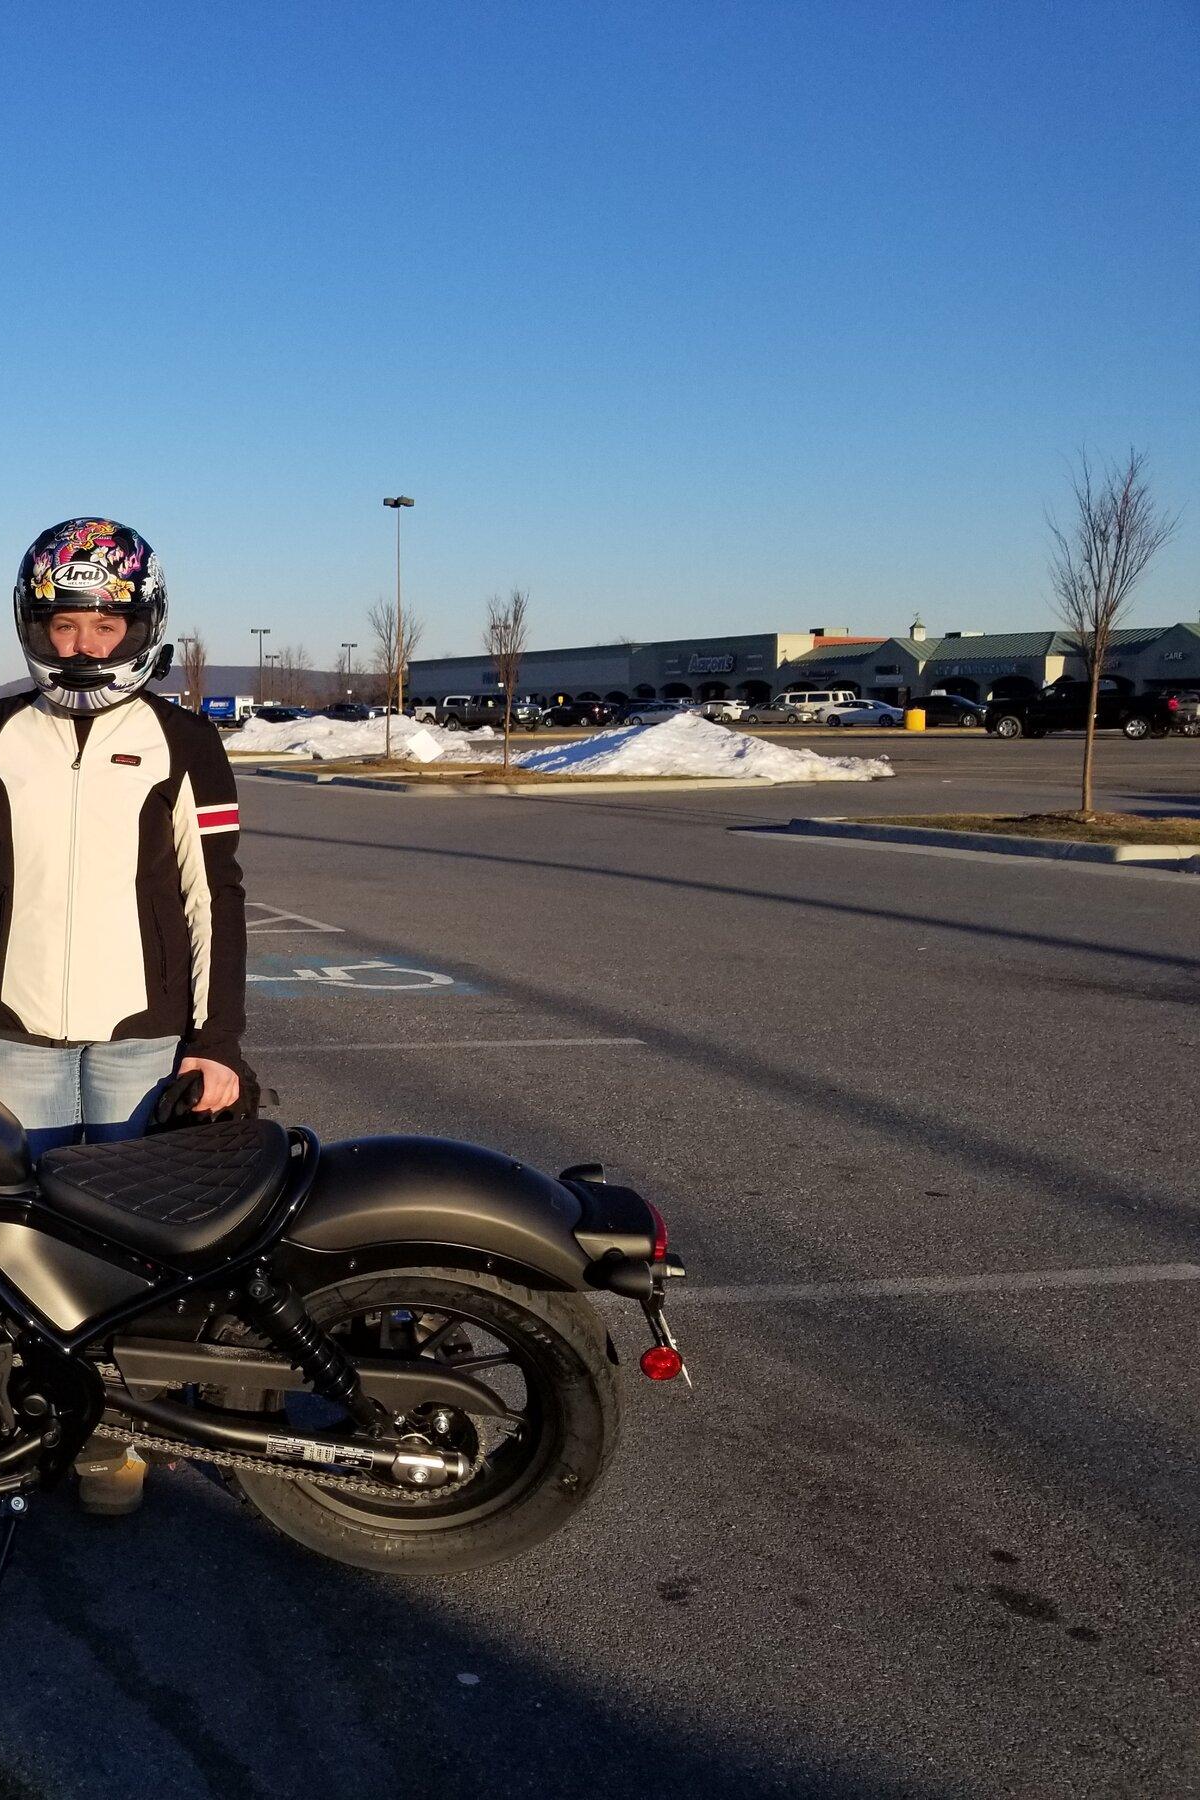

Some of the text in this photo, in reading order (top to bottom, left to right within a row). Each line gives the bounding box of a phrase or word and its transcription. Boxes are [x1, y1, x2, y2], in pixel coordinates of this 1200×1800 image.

[55, 566, 101, 581] Arai
[688, 653, 733, 673] Aaron's
[1164, 652, 1183, 660] CARE
